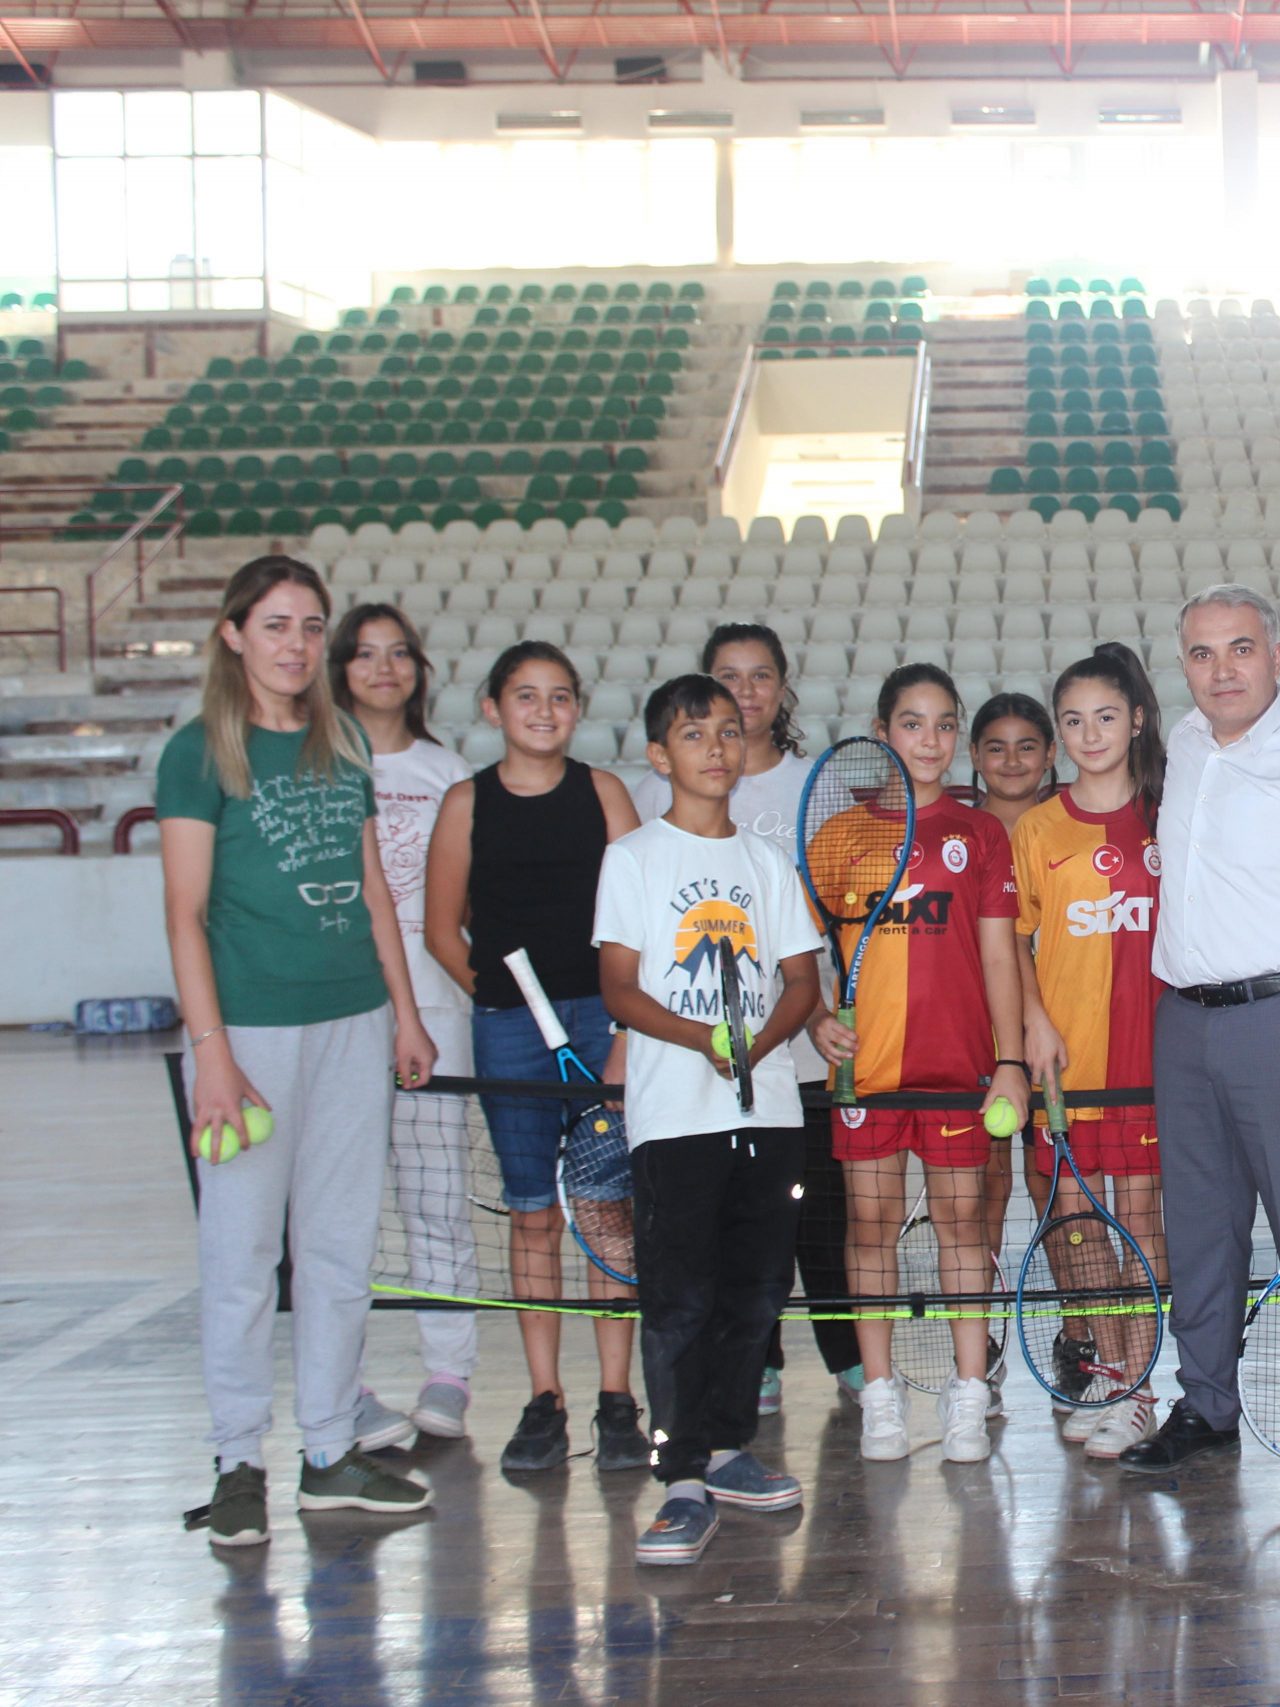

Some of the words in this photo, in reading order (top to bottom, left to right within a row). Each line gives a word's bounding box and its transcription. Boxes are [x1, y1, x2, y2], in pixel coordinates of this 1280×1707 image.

[752, 811, 797, 839] Oce
[670, 878, 720, 915] LET'S
[729, 885, 752, 909] GO
[1002, 881, 1018, 893] HOL
[692, 919, 746, 935] SUMMER
[1066, 890, 1154, 937] SIXT
[878, 926, 908, 935] rent
[911, 927, 921, 935] a
[924, 926, 948, 935] car
[850, 936, 871, 989] ARTENGO
[668, 988, 765, 1018] CAMNG
